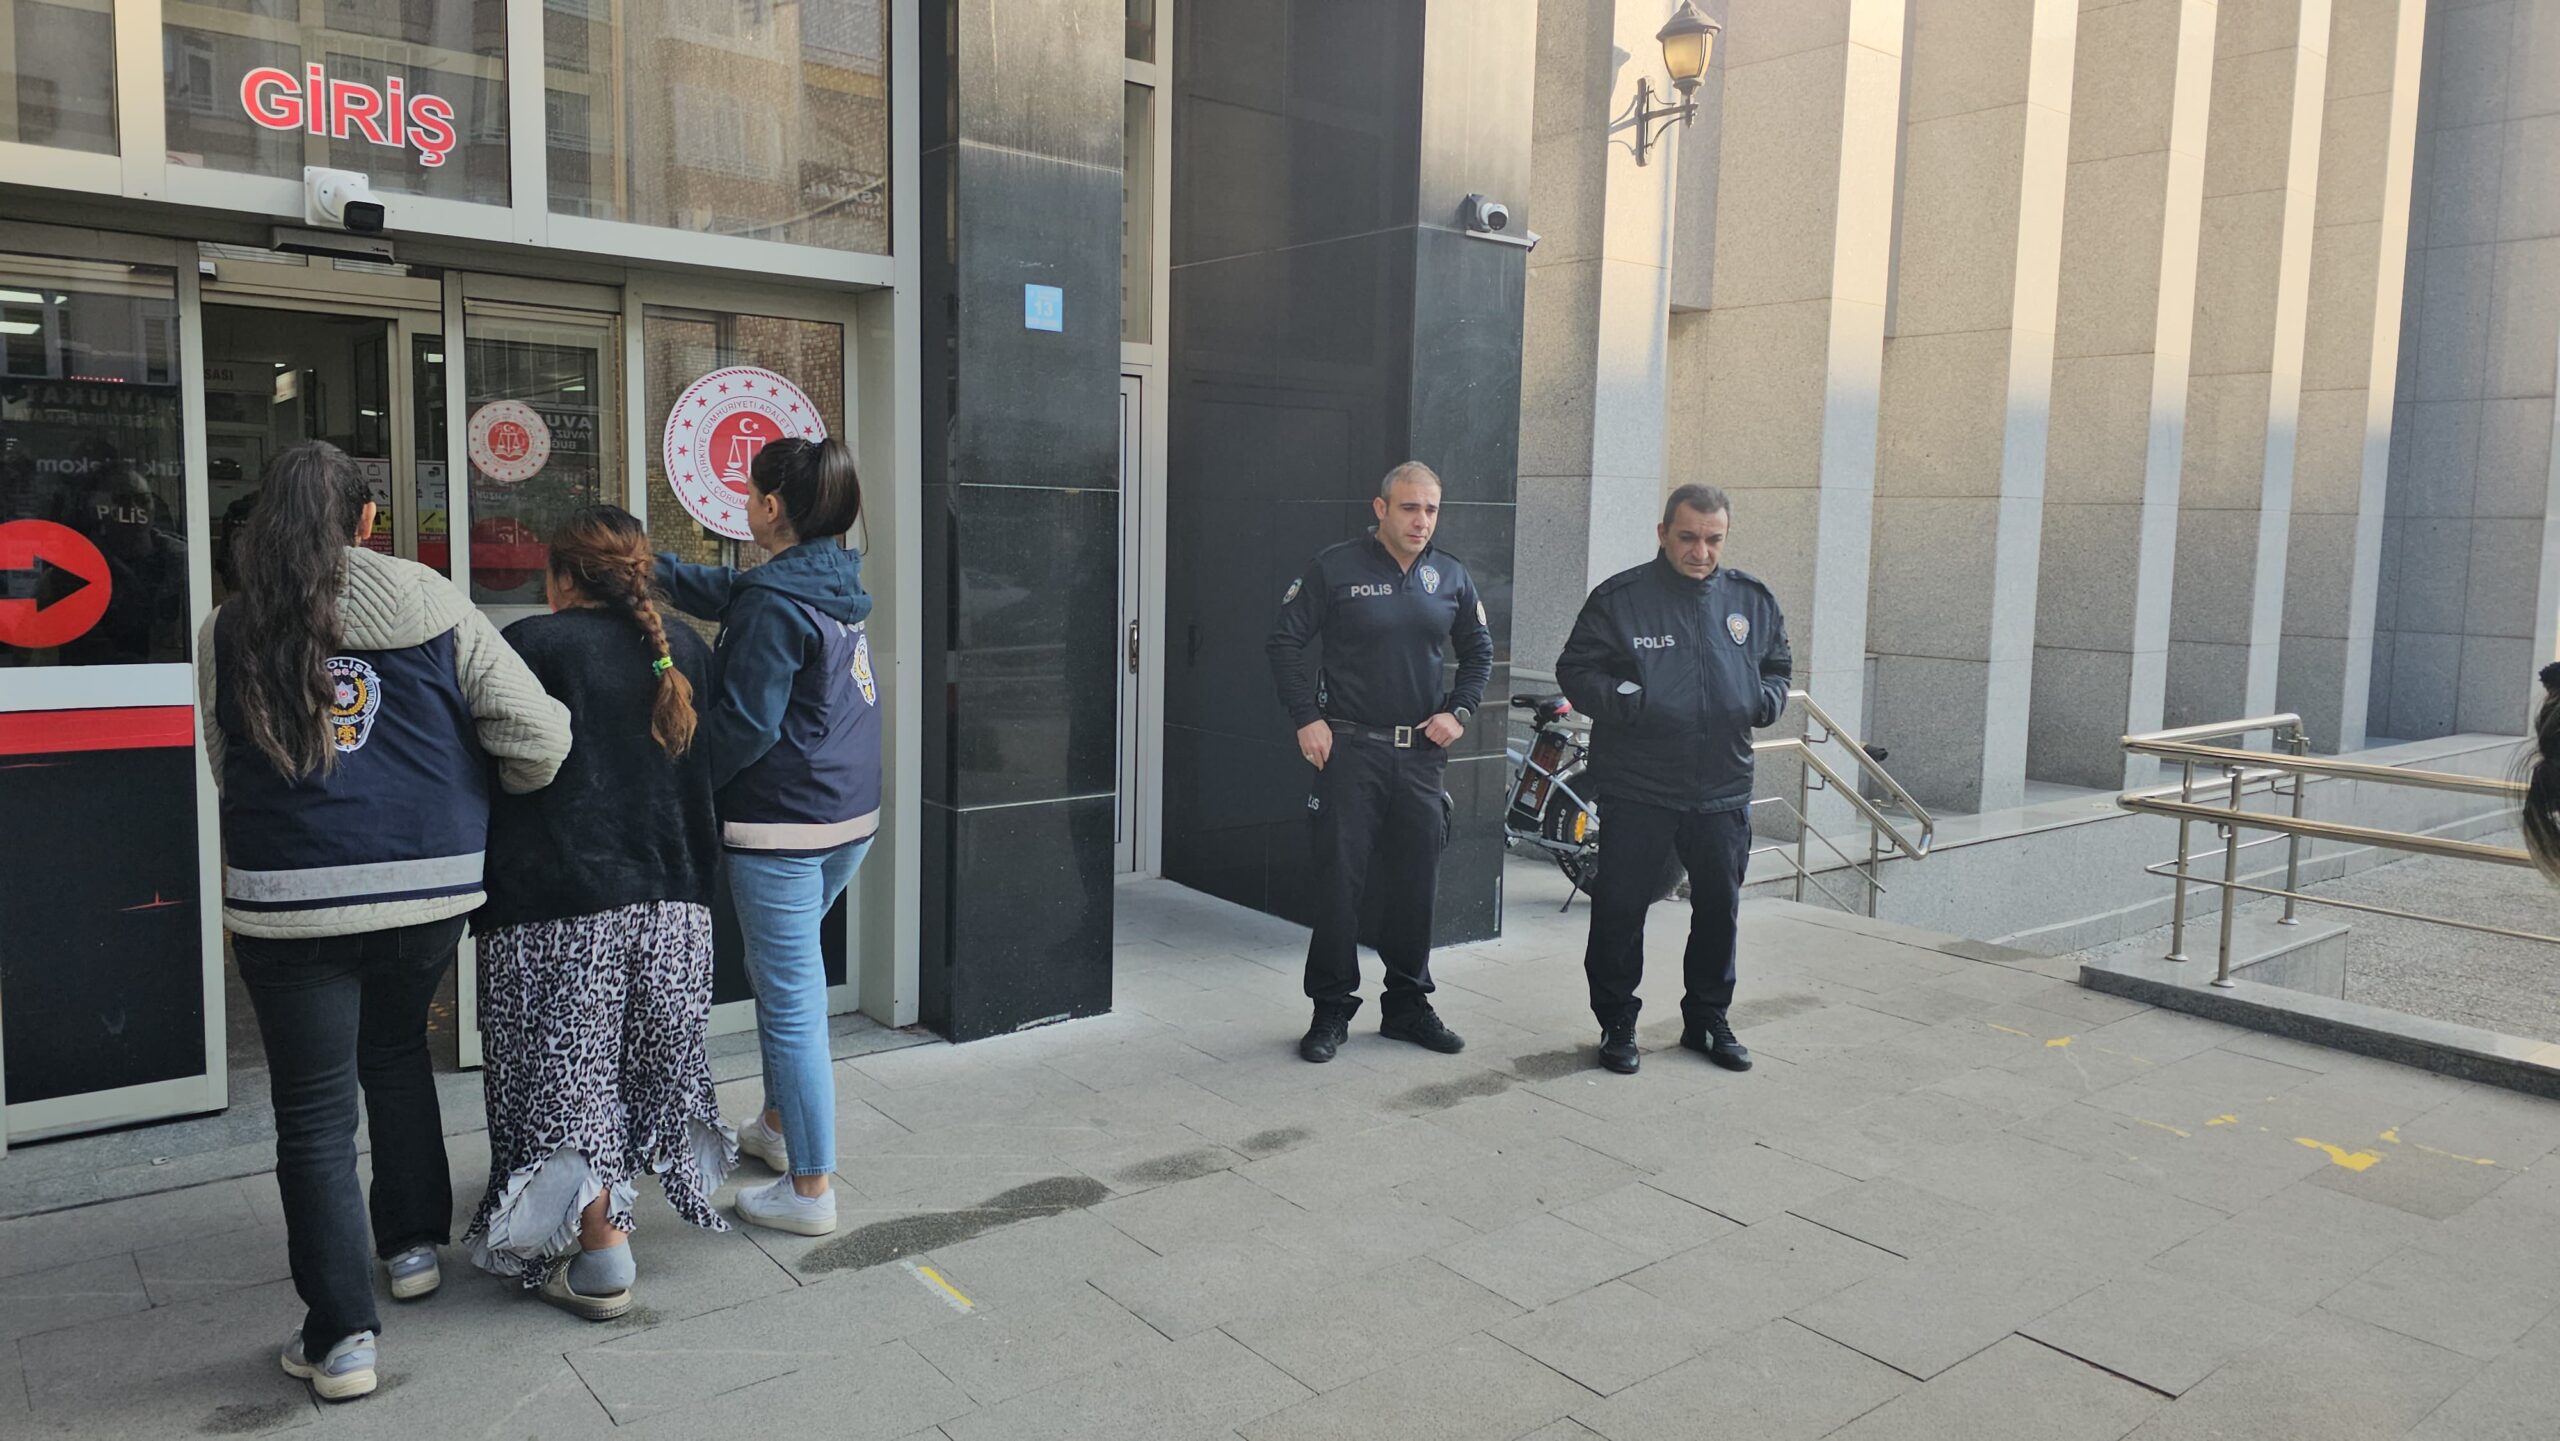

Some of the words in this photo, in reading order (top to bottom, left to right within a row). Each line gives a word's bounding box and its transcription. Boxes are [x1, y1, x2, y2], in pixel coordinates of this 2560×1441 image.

[240, 62, 457, 167] GİRİŞ
[702, 400, 757, 434] CUMHURİYETİ
[759, 403, 790, 430] ADALET
[698, 436, 712, 479] TÜRKİYE
[713, 485, 746, 506] ÇORUM
[96, 504, 149, 525] PLİS
[1351, 583, 1393, 598] POLİS
[1633, 634, 1676, 649] POLİS
[326, 659, 364, 673] OLİS
